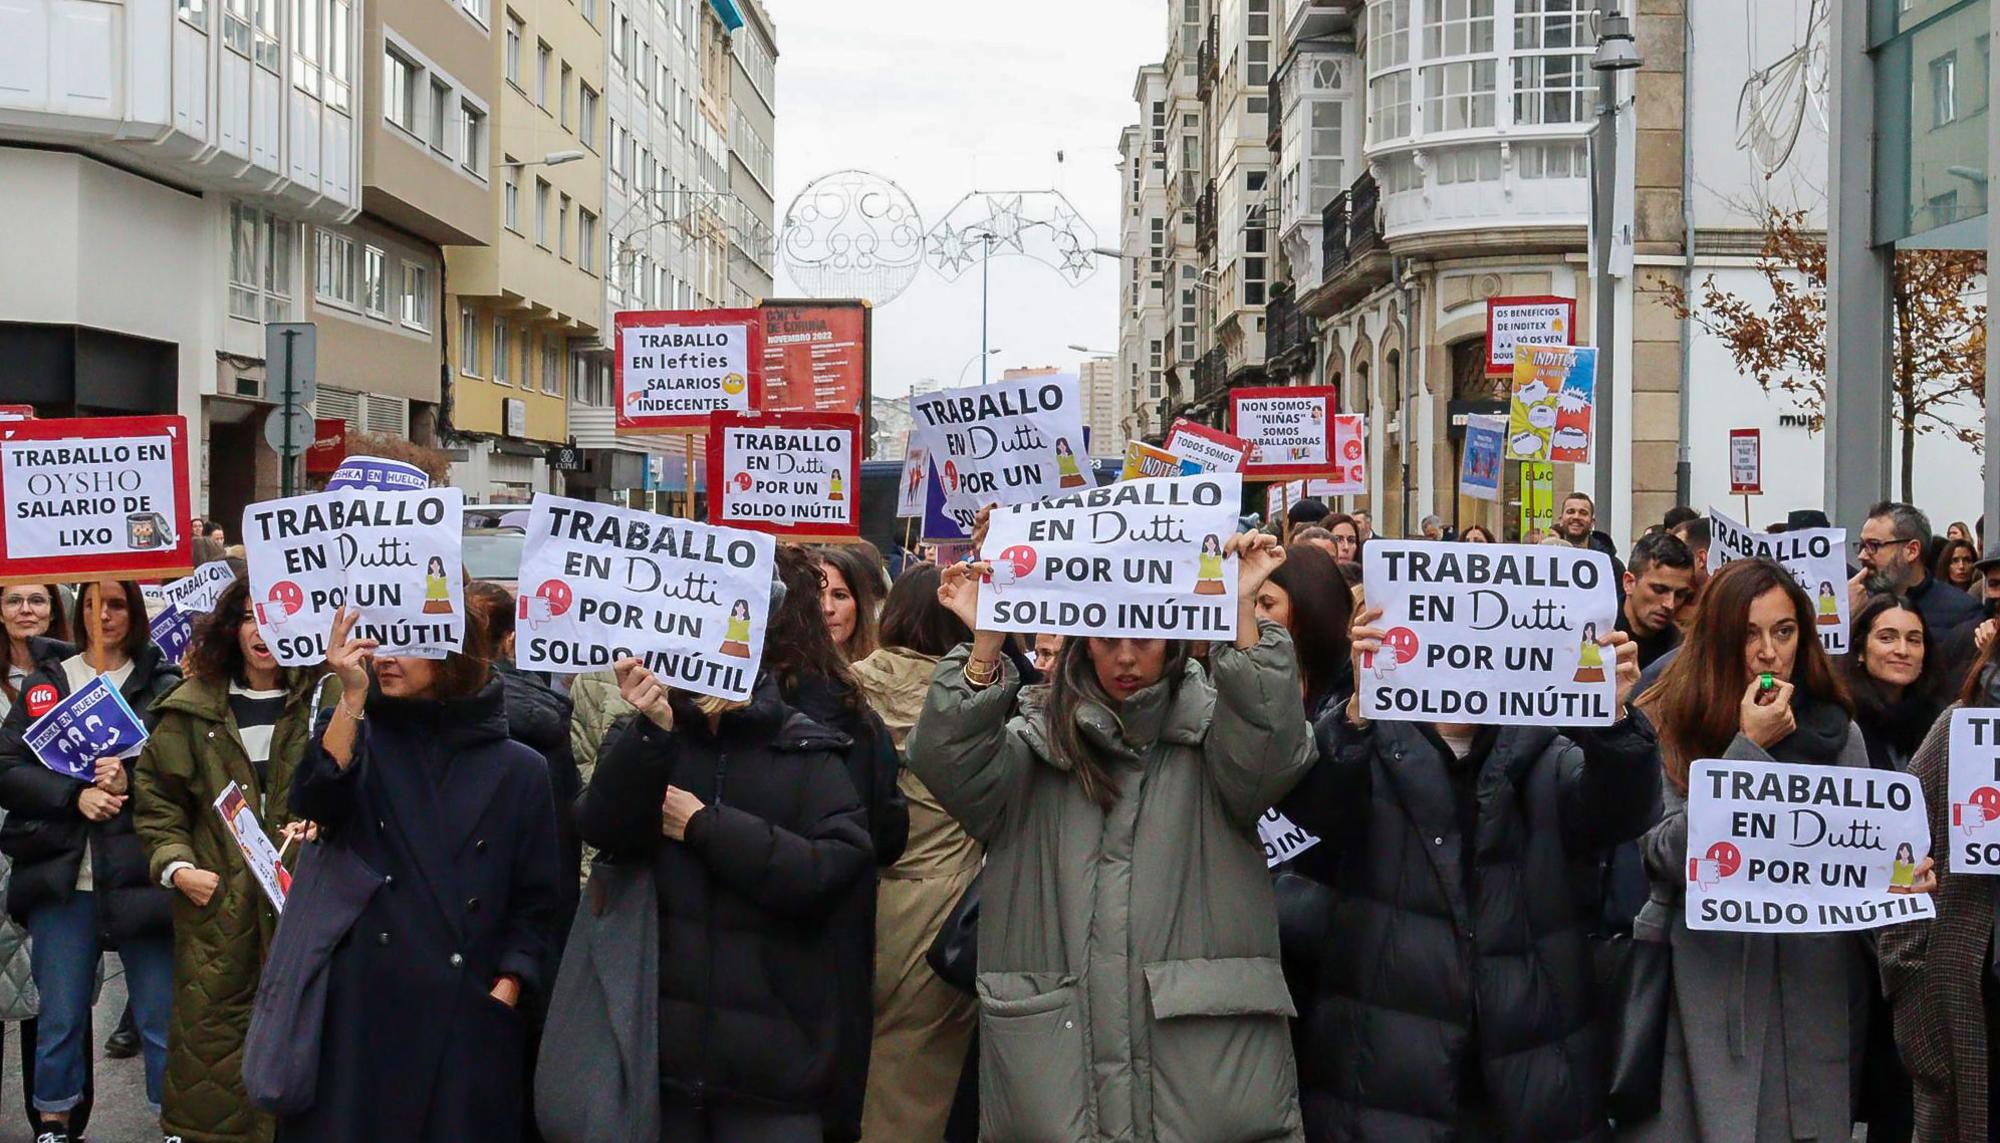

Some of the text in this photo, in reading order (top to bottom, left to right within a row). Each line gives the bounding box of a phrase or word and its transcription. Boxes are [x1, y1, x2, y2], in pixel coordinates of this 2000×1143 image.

[639, 333, 728, 348] TRABALLO
[1511, 322, 1546, 331] INDITEX
[1544, 335, 1563, 343] VEN
[633, 353, 728, 369] EN lefties
[647, 377, 721, 391] SALARIOS
[638, 398, 729, 411] INDECENTES
[916, 384, 1063, 426] TRABALLO
[1241, 401, 1312, 411] NON SOMOS
[734, 434, 841, 453] TRABALLO
[948, 424, 1048, 460] EN Dutti
[1263, 427, 1299, 436] SOMOS
[12, 444, 166, 467] TRABALLO EN
[746, 453, 827, 475] EN Dutti
[1178, 437, 1204, 453] TODOS
[1204, 447, 1234, 463] SOMOS
[28, 469, 141, 496] OYSHO
[368, 471, 380, 480] EN
[387, 472, 426, 487] HUELGA
[756, 481, 818, 495] POR UN
[960, 464, 1042, 494] POR UN
[17, 496, 150, 519] SALARIO DE
[255, 498, 445, 541] TRABALLO
[731, 501, 846, 519] SOLDO INÚTIL
[59, 528, 113, 547] LIXO
[548, 506, 756, 569] TRABALLO
[1028, 510, 1192, 543] EN Dutti
[1710, 514, 1831, 562] TRABALLO
[284, 533, 418, 575] EN Dutti
[167, 567, 219, 603] TRABALLO
[564, 551, 722, 606] EN Dutti
[1045, 557, 1172, 584] POR UN
[1382, 551, 1599, 590] TRABALLO
[310, 583, 401, 613] PO UN
[1408, 589, 1573, 632] EN Dutti
[579, 598, 703, 638] POR UN
[993, 599, 1230, 631] SOLDO INÚTIL
[277, 619, 459, 659] SOL INÚTIL
[644, 651, 747, 694] INÚTIL
[1427, 644, 1554, 672] POR UN
[72, 687, 108, 715] HUELGA
[1375, 686, 1609, 718] SOLDO INÚTIL
[1706, 769, 1912, 812] TRABALLO
[1731, 809, 1887, 851] EN Dutti
[1748, 859, 1867, 888] POR UN
[1701, 896, 1929, 925] SOLDO INÚTIL
